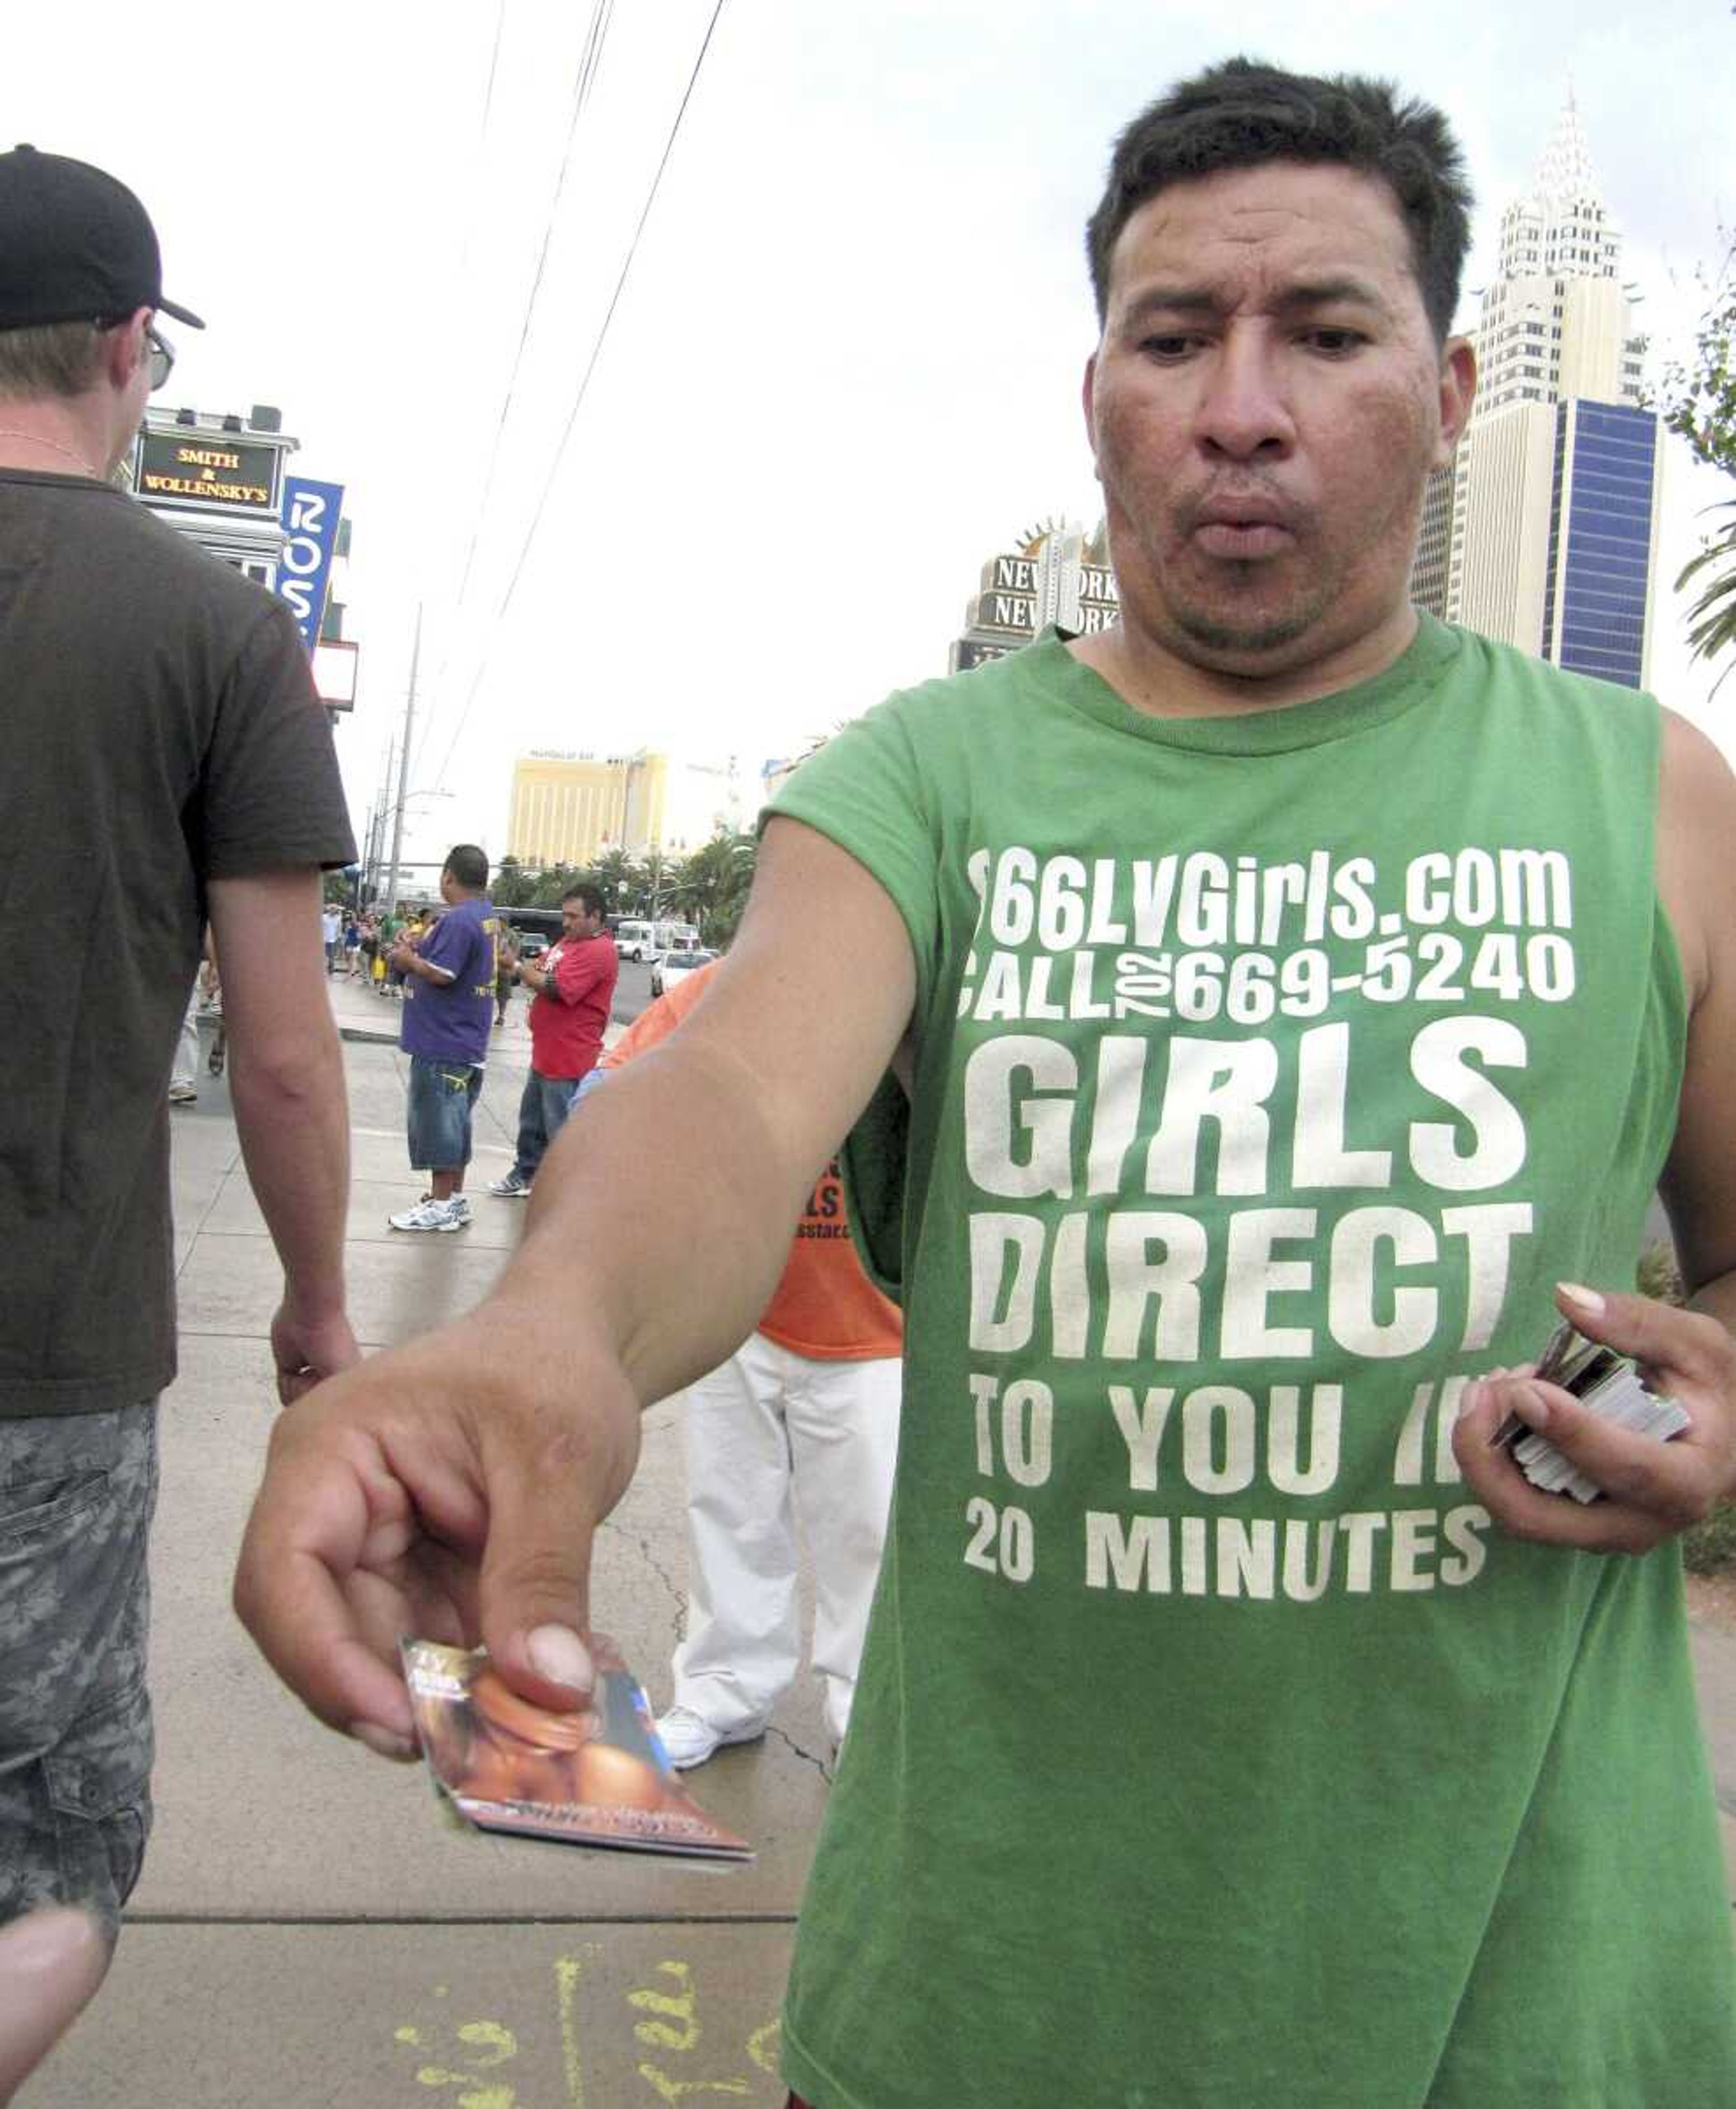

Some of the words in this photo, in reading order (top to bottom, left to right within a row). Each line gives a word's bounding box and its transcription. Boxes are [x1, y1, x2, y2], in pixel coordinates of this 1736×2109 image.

[146, 474, 268, 502] WOLLENSKY'S
[178, 448, 240, 468] SMITH
[202, 468, 215, 481] &
[281, 491, 326, 636] ROS
[1115, 952, 1172, 1019] 702
[1174, 933, 1575, 1025] 669-5240
[964, 1015, 1527, 1199] GIRLS
[969, 1203, 1533, 1361] DIRECT
[969, 1374, 1053, 1487] TO
[1108, 1384, 1343, 1495] YOU
[963, 1496, 1035, 1583] 20
[1085, 1504, 1491, 1601] MINUTES
